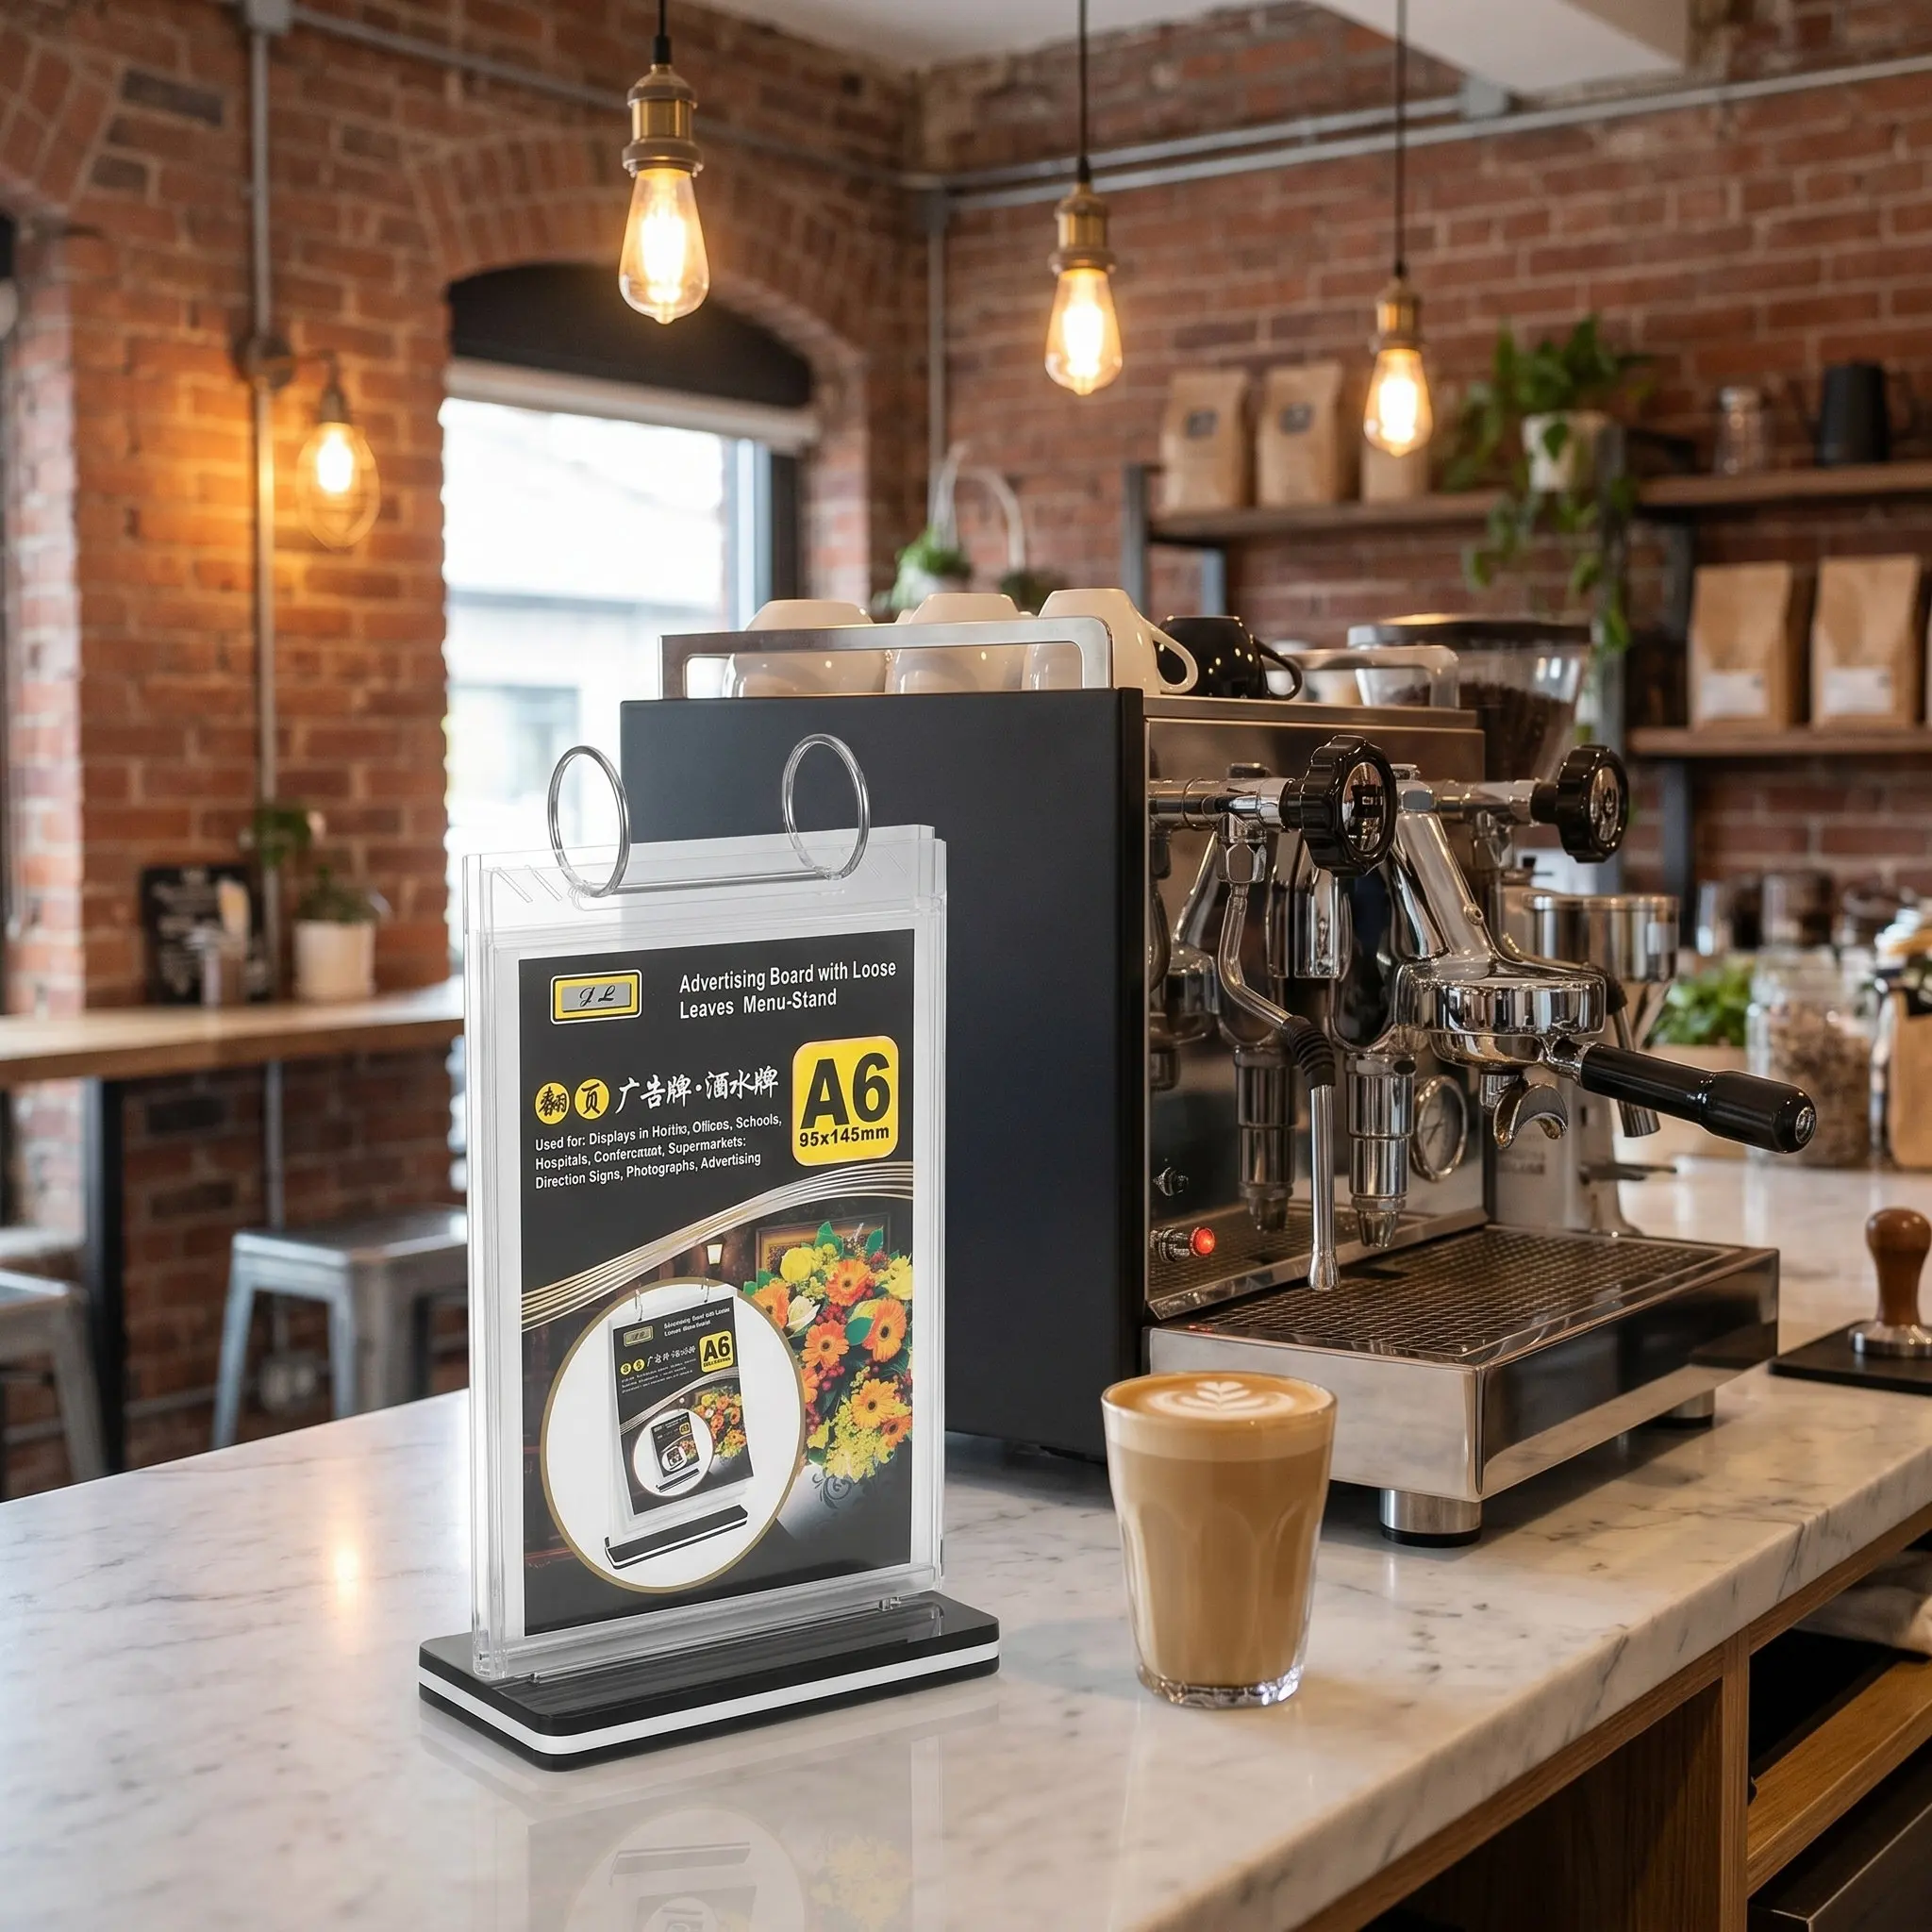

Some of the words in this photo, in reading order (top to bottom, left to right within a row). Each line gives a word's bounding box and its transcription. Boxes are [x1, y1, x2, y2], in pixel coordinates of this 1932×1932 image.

[679, 970, 766, 993] Advertising
[770, 964, 814, 986] Board
[818, 961, 848, 982] with
[853, 960, 897, 979] Loose
[680, 1001, 735, 1019] Leaves
[743, 989, 838, 1013] Menu-Stand
[800, 1052, 891, 1130] A6
[535, 1137, 564, 1151] Used
[567, 1135, 586, 1148] for:
[589, 1130, 636, 1146] Displays
[639, 1127, 649, 1140] in
[736, 1113, 782, 1128] Schools,
[799, 1126, 891, 1148] 95x145mm
[535, 1154, 591, 1170] Hospitals,
[668, 1137, 746, 1156] Supermarkets:
[535, 1174, 586, 1189] Direction
[589, 1170, 624, 1185] Signs,
[626, 1160, 698, 1178] Photographs,
[700, 1153, 761, 1169] Advertising
[703, 1335, 731, 1361] A6
